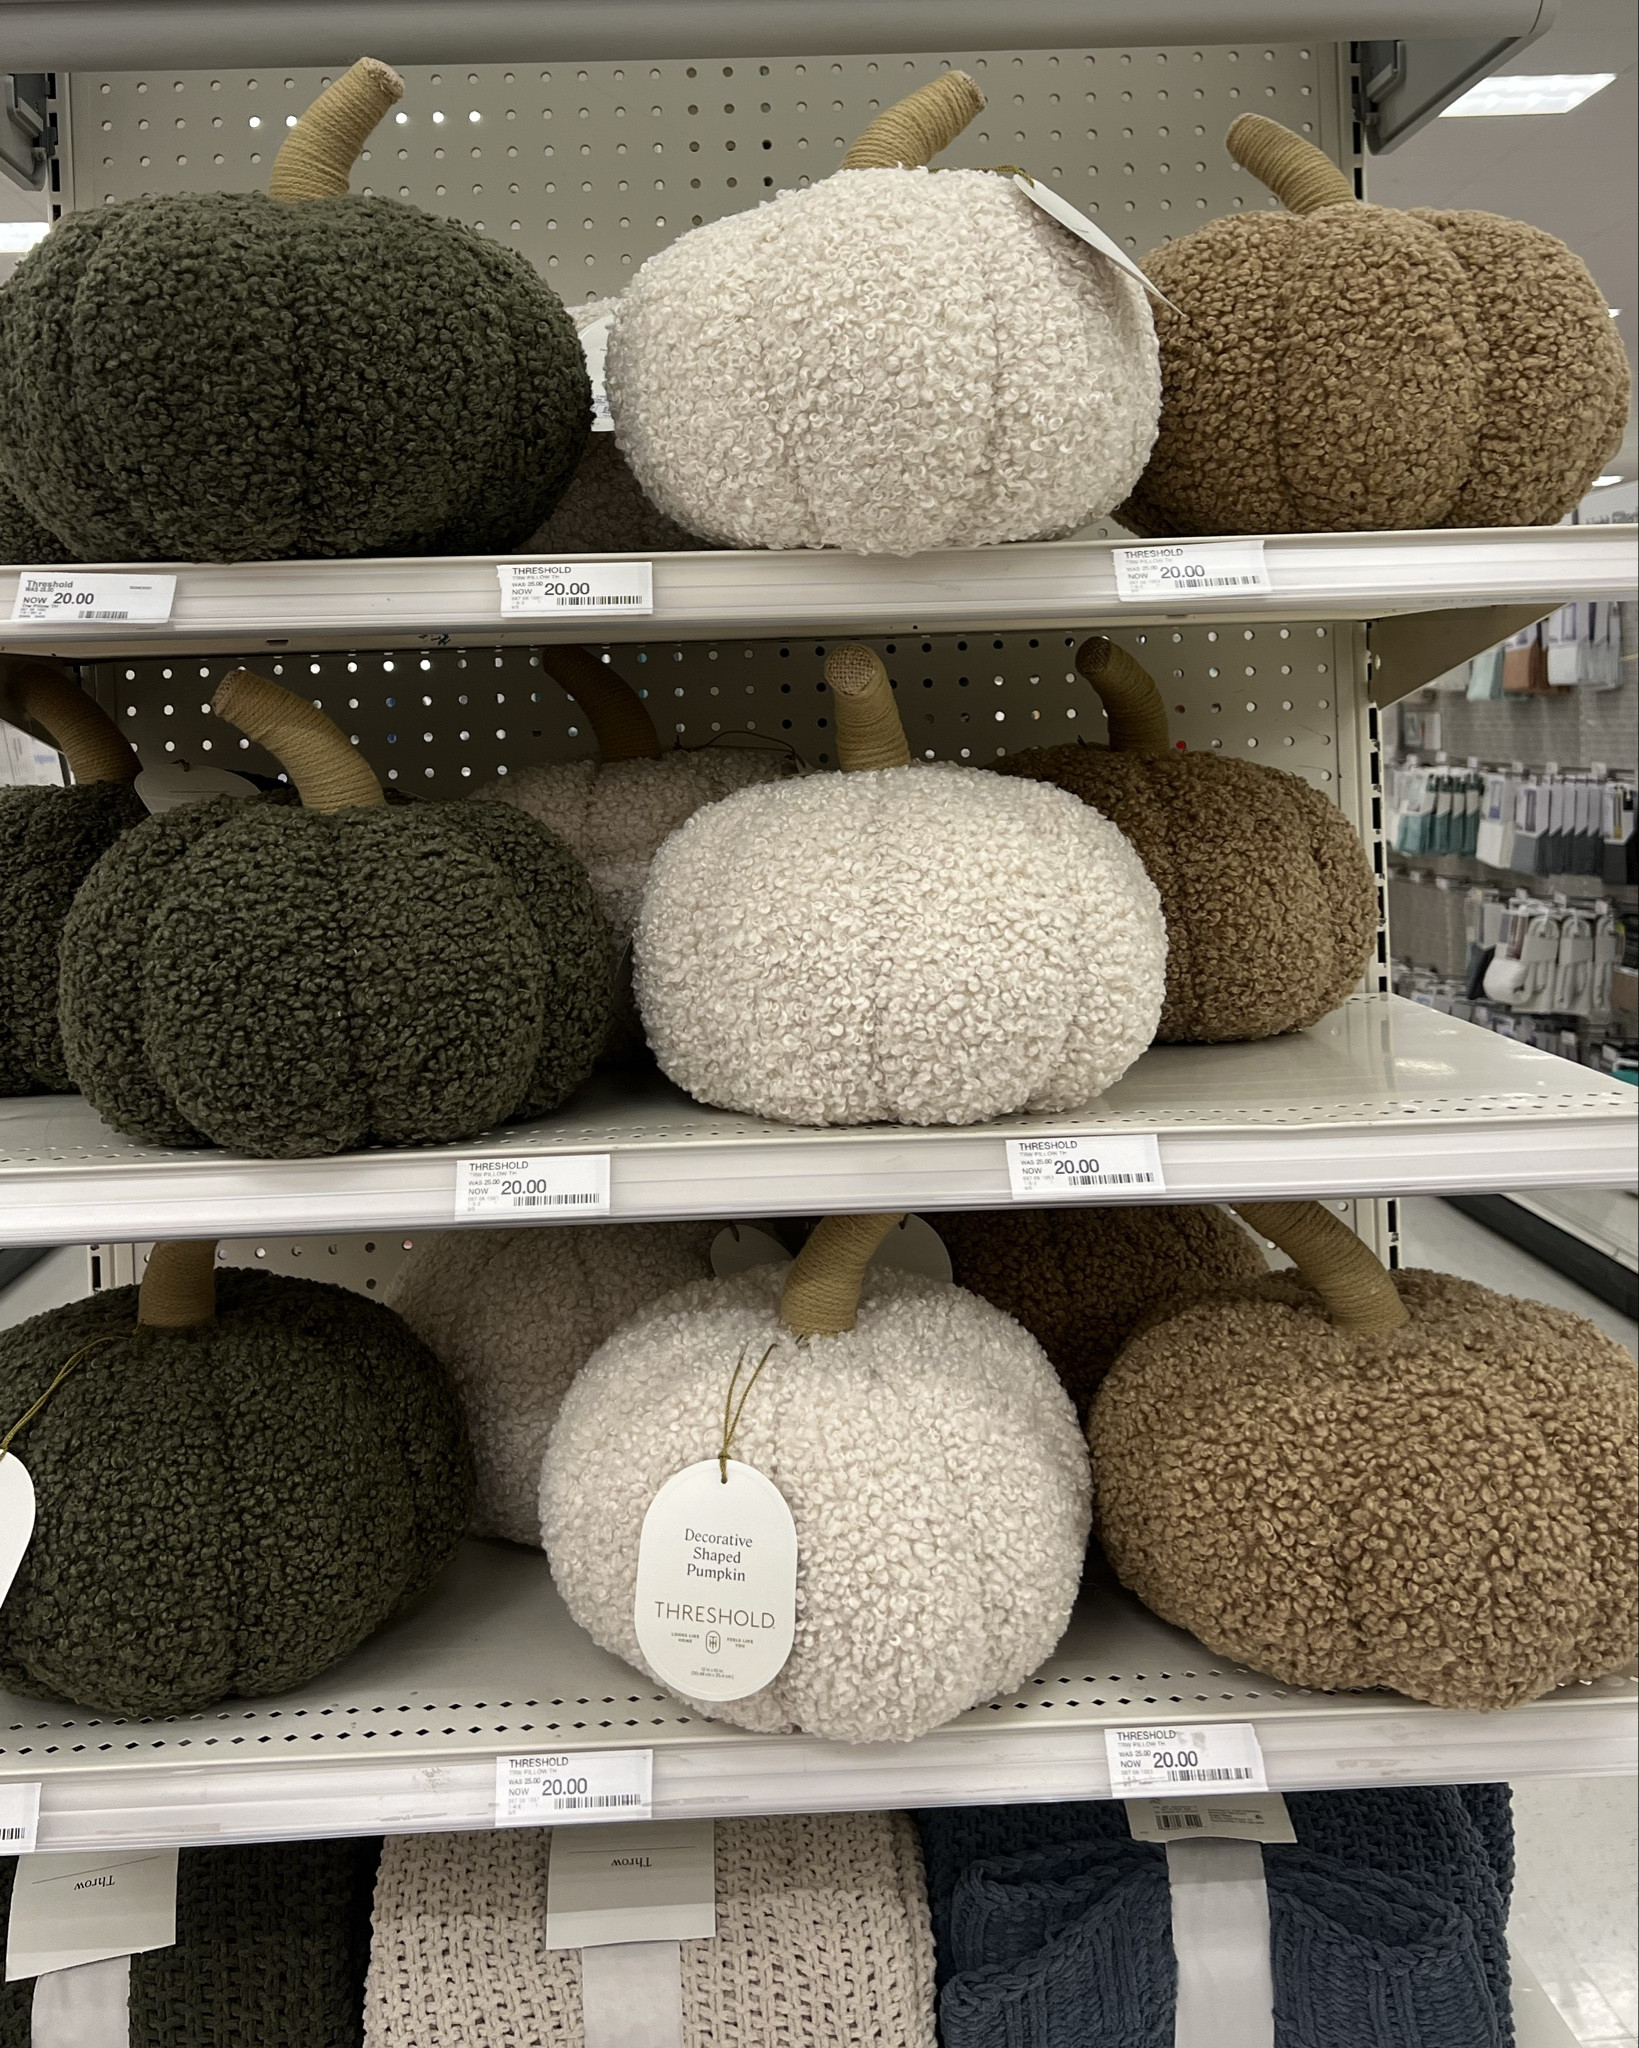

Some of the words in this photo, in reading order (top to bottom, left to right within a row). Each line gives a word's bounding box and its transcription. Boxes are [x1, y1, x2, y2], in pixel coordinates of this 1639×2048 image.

[1124, 549, 1183, 559] THRESHOLD
[512, 567, 571, 575] THRESHOLD
[1128, 572, 1148, 580] NOW
[1160, 565, 1205, 579] 20.00
[27, 580, 73, 589] Threshold
[544, 583, 590, 596] 20.00
[53, 592, 94, 605] 20.00
[1019, 1141, 1078, 1151] THRESHOLD
[469, 1161, 529, 1171] THRESHOLD
[1022, 1167, 1042, 1175] NOW
[1054, 1159, 1100, 1175] 20.00
[501, 1179, 547, 1195] 20.00
[684, 1528, 753, 1548] Decorative
[693, 1547, 741, 1564] Shaped
[686, 1563, 746, 1582] Pumpkin
[654, 1601, 775, 1629] THRESHOLD
[1116, 1730, 1176, 1741] THRESHOLD
[509, 1757, 569, 1768] THRESHOLD
[1120, 1760, 1141, 1768] NOW
[1152, 1750, 1198, 1768] 20.00
[509, 1788, 529, 1796] NOW
[542, 1778, 588, 1796] 20.00
[611, 1857, 652, 1867] Throw
[73, 1875, 115, 1891] Throw
